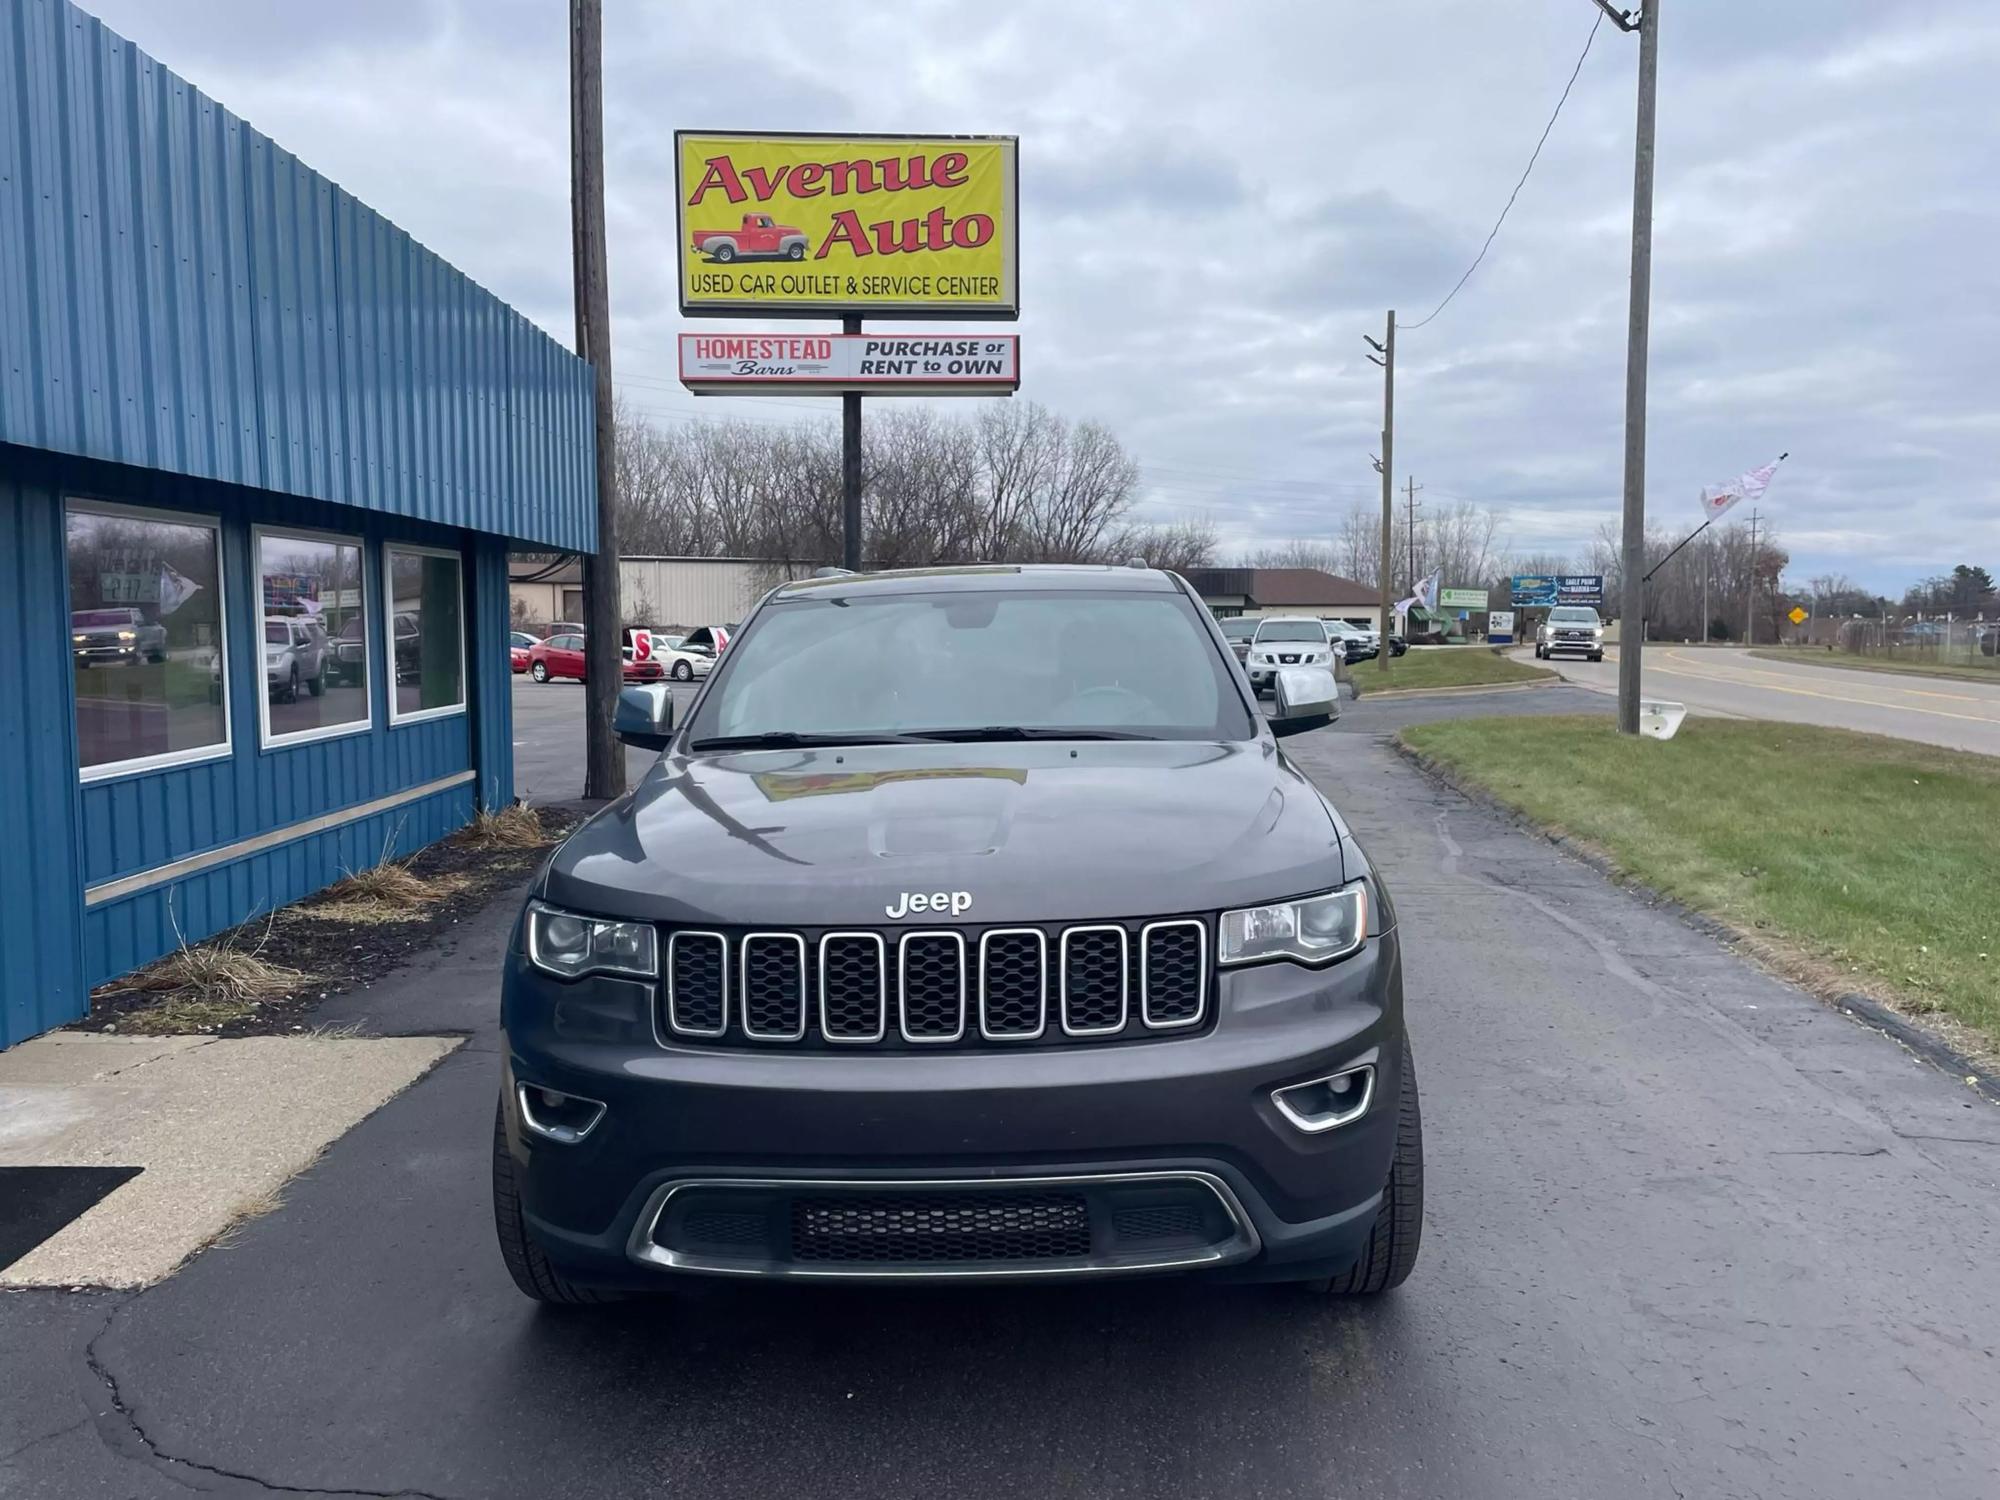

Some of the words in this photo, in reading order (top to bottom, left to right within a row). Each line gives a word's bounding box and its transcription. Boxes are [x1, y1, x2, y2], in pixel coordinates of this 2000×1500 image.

[688, 151, 969, 206] Avenue
[814, 206, 995, 260] Auto
[692, 274, 734, 293] USED
[740, 274, 776, 294] CAR
[781, 275, 840, 294] OUTLET
[846, 276, 858, 295] &
[862, 276, 931, 295] SERVICE
[936, 276, 999, 295] CENTER
[696, 339, 832, 360] HOMESTEAD
[865, 341, 980, 356] PURCHASE
[985, 343, 1005, 354] or
[731, 360, 797, 376] Barns
[860, 360, 917, 375] RENT
[923, 360, 942, 372] to
[948, 360, 1003, 375] OWN
[635, 633, 650, 661] S
[885, 891, 973, 920] Jeep
